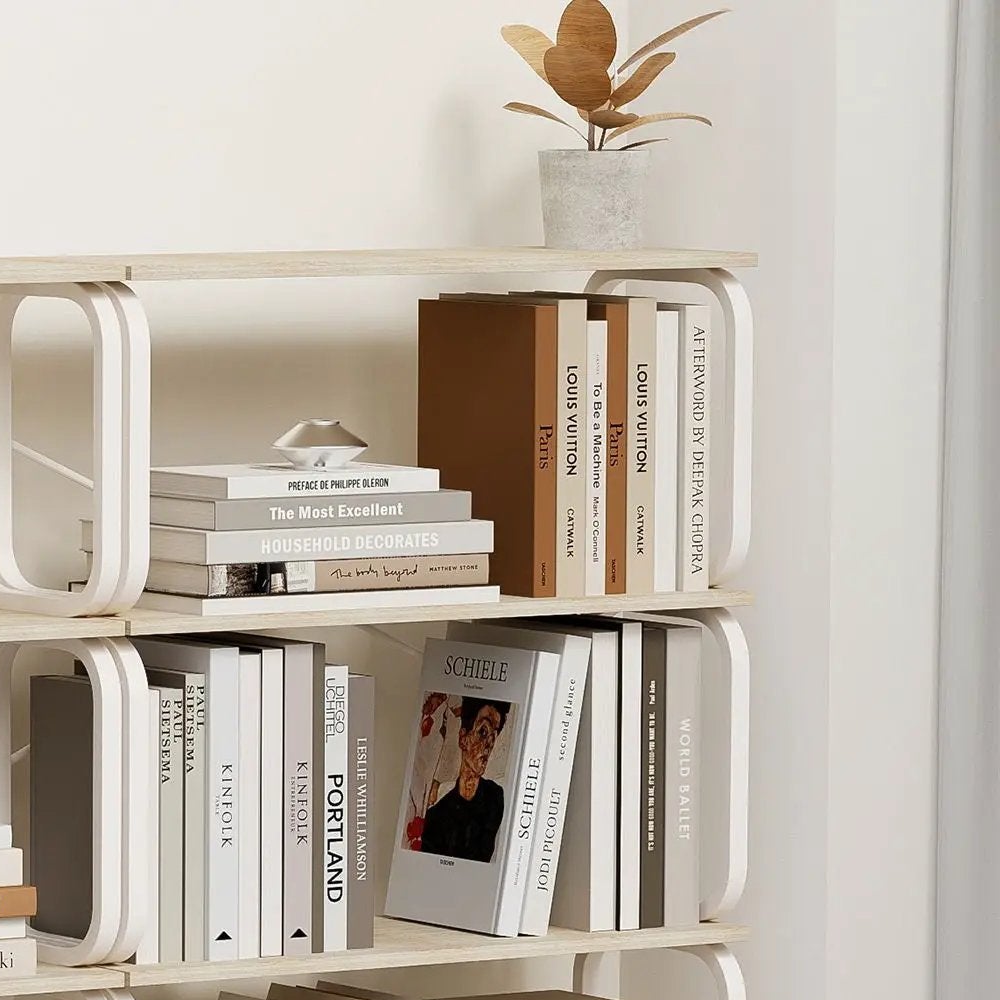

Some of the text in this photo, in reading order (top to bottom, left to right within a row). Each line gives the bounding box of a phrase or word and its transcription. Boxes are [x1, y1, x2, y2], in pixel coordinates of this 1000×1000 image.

[539, 425, 552, 469] Paris
[566, 365, 578, 476] LOUIS VUITTON
[609, 422, 623, 466] Paris
[636, 364, 648, 473] LOUIS VUITTON
[592, 434, 602, 489] Machine
[691, 325, 706, 575] AFTERWORD DEEPAK CHOPRA
[269, 502, 404, 521] The Most Excellent
[566, 508, 574, 558] CATWALK
[592, 496, 600, 518] Mark
[636, 505, 644, 556] CATWALK
[261, 532, 439, 555] HOUSEHOLD DECORATES
[384, 564, 418, 582] beyond
[444, 655, 508, 682] SCHIELE
[174, 700, 182, 743] PAUL
[186, 685, 194, 773] SIETSEMA
[326, 678, 336, 742] UCHITEL
[336, 686, 345, 734] DIEGO
[559, 679, 576, 760] second glance
[162, 700, 170, 784] SIETSEMA
[680, 718, 690, 777] WORLD
[222, 764, 232, 848] KINFOLK
[297, 762, 308, 846] KINFOLK
[356, 738, 368, 881] LESLIE WHILLIAMSON
[518, 757, 540, 840] SCHIELE
[542, 788, 561, 852] PICOULT
[328, 774, 344, 903] PORTLAND
